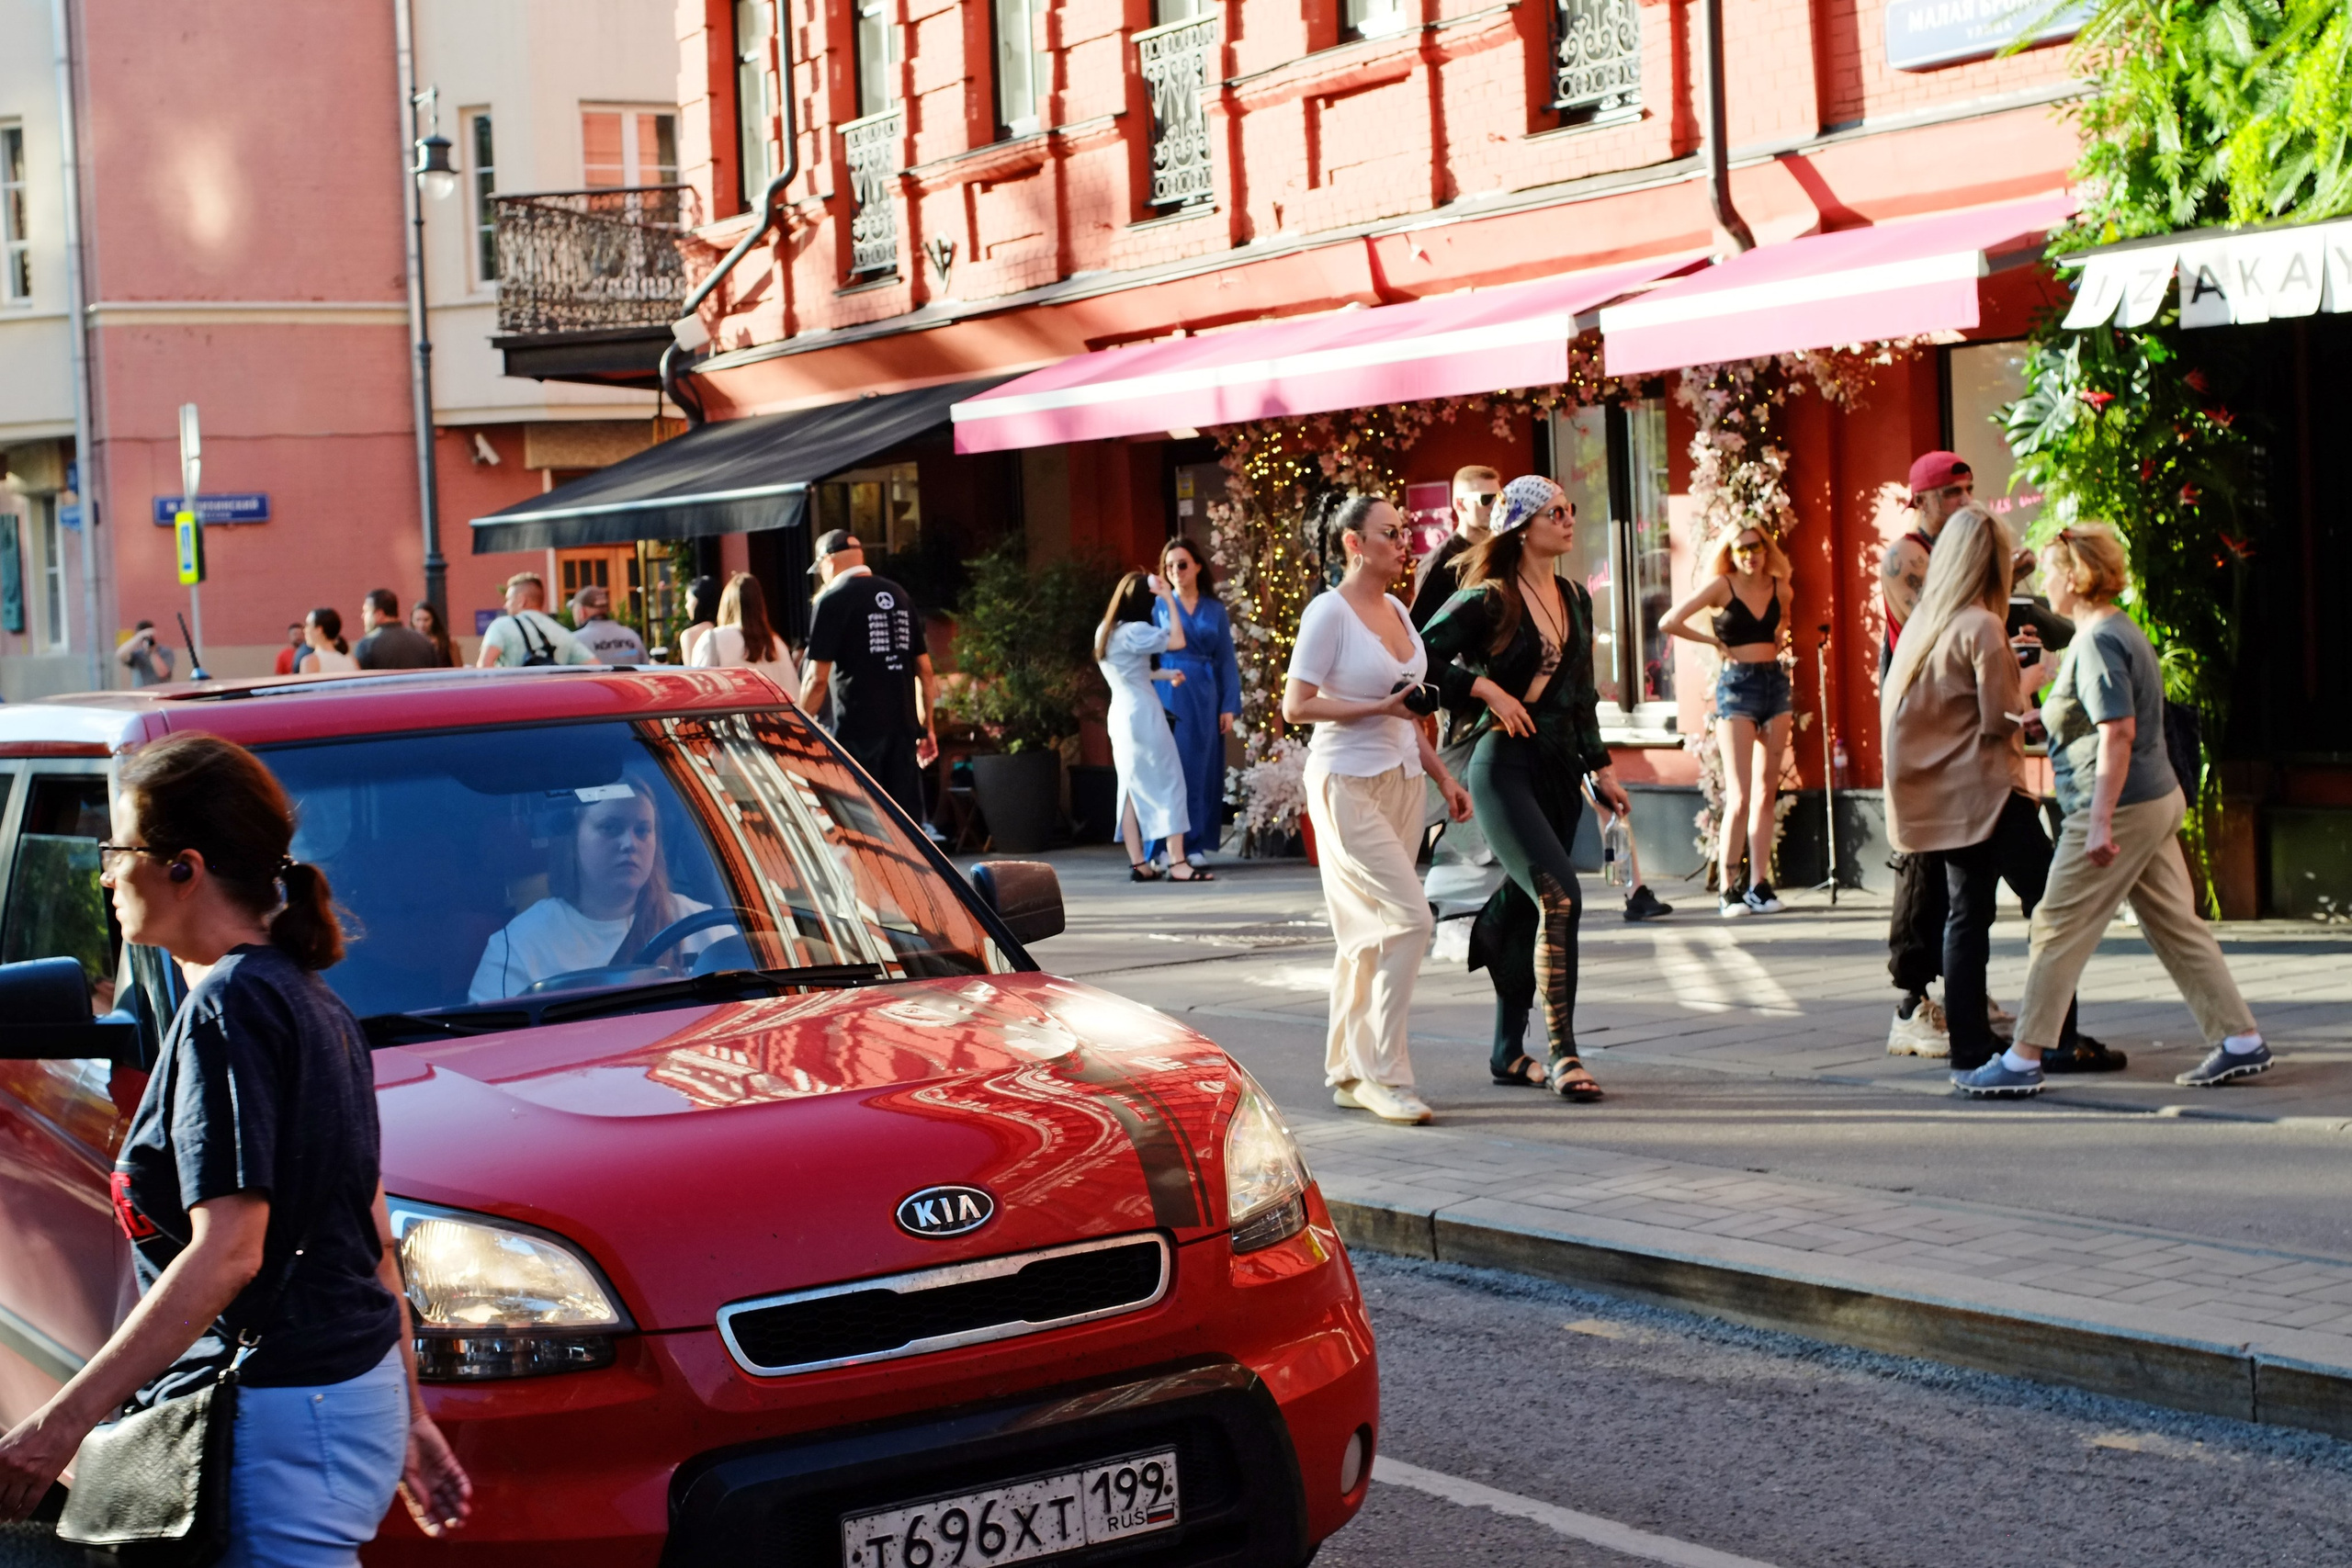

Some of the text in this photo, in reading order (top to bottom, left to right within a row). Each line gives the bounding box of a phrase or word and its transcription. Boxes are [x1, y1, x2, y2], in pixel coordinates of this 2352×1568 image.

[911, 1194, 982, 1228] KIA
[1091, 1461, 1165, 1515] 199
[1107, 1509, 1146, 1532] RUS
